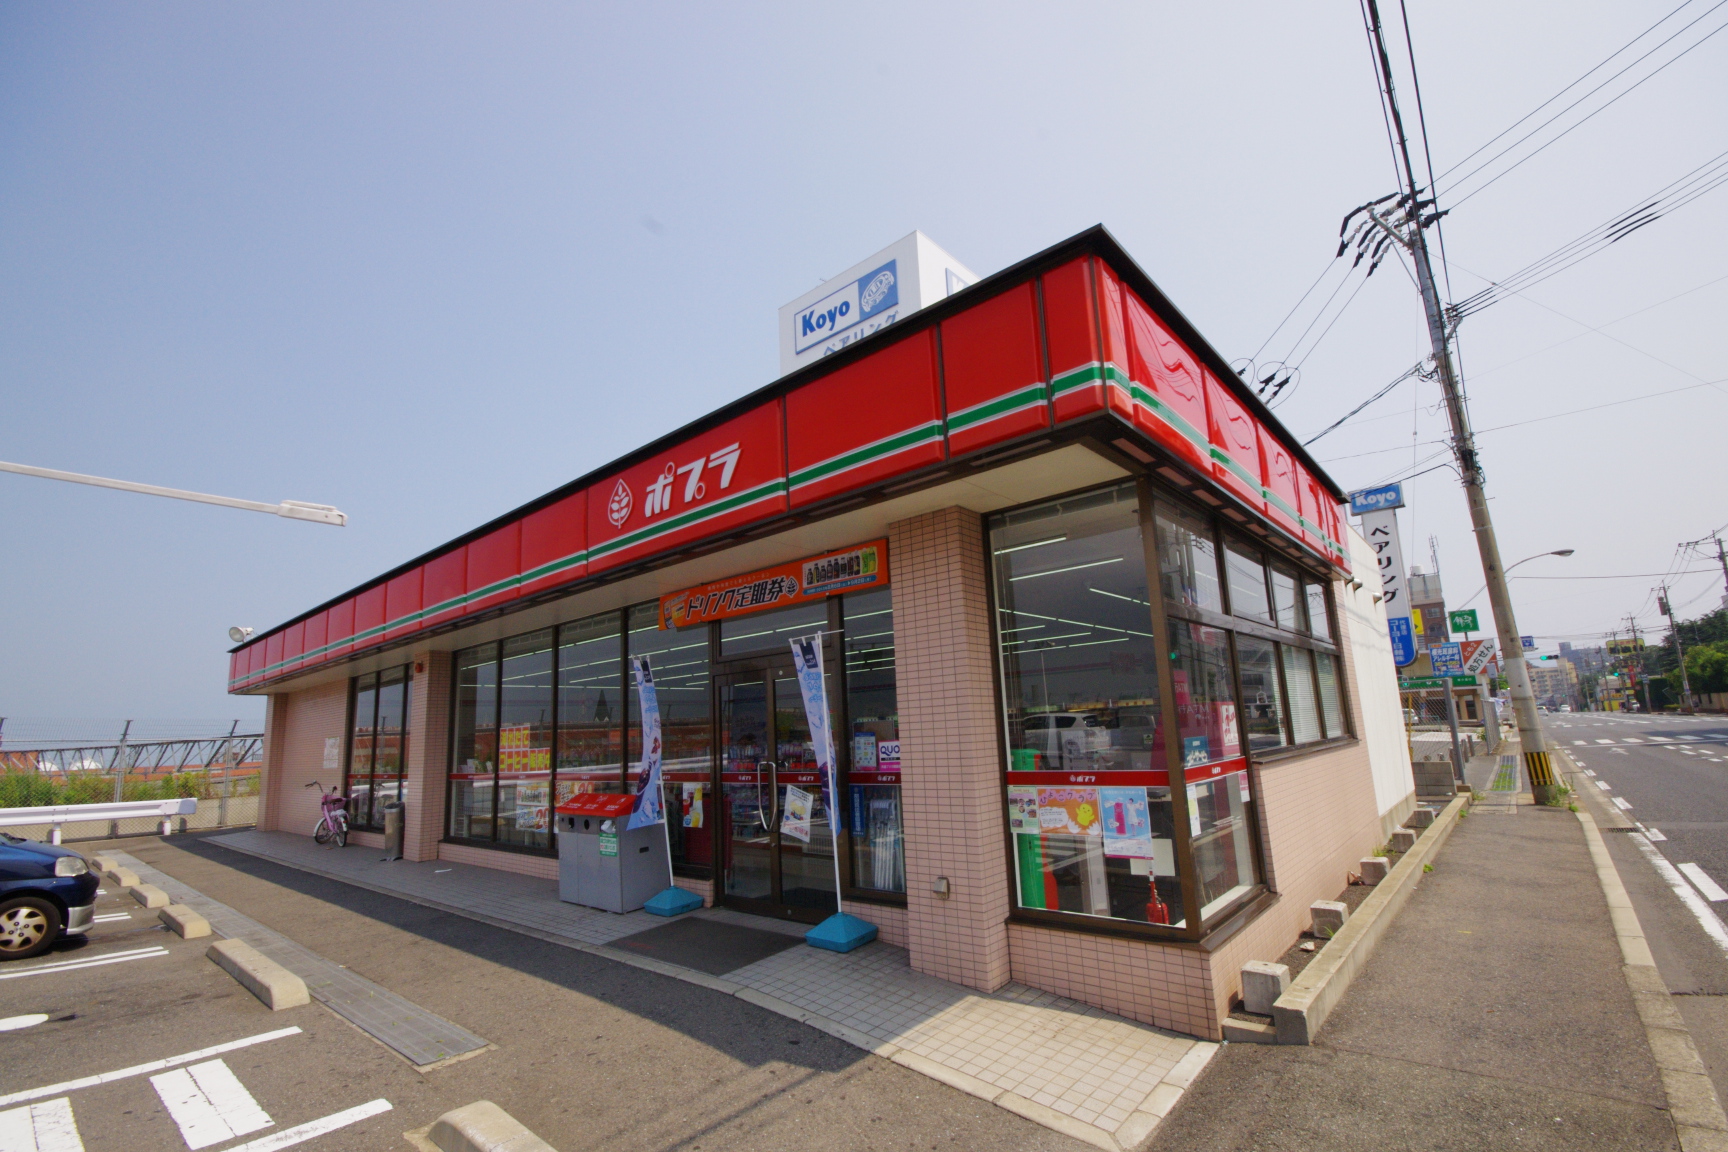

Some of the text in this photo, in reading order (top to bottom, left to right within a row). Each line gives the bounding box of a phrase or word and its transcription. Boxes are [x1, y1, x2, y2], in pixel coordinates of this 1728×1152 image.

[801, 300, 850, 337] Koyo
[644, 441, 741, 518] ポプラ
[1355, 489, 1397, 507] Koyo
[1370, 525, 1398, 604] ベアリング
[685, 576, 787, 620] ドリンク定期券
[1467, 643, 1494, 673] 処方せん
[880, 745, 901, 756] QUO
[1076, 774, 1096, 783] ポプラ
[1039, 790, 1095, 804] ひよこクラブ
